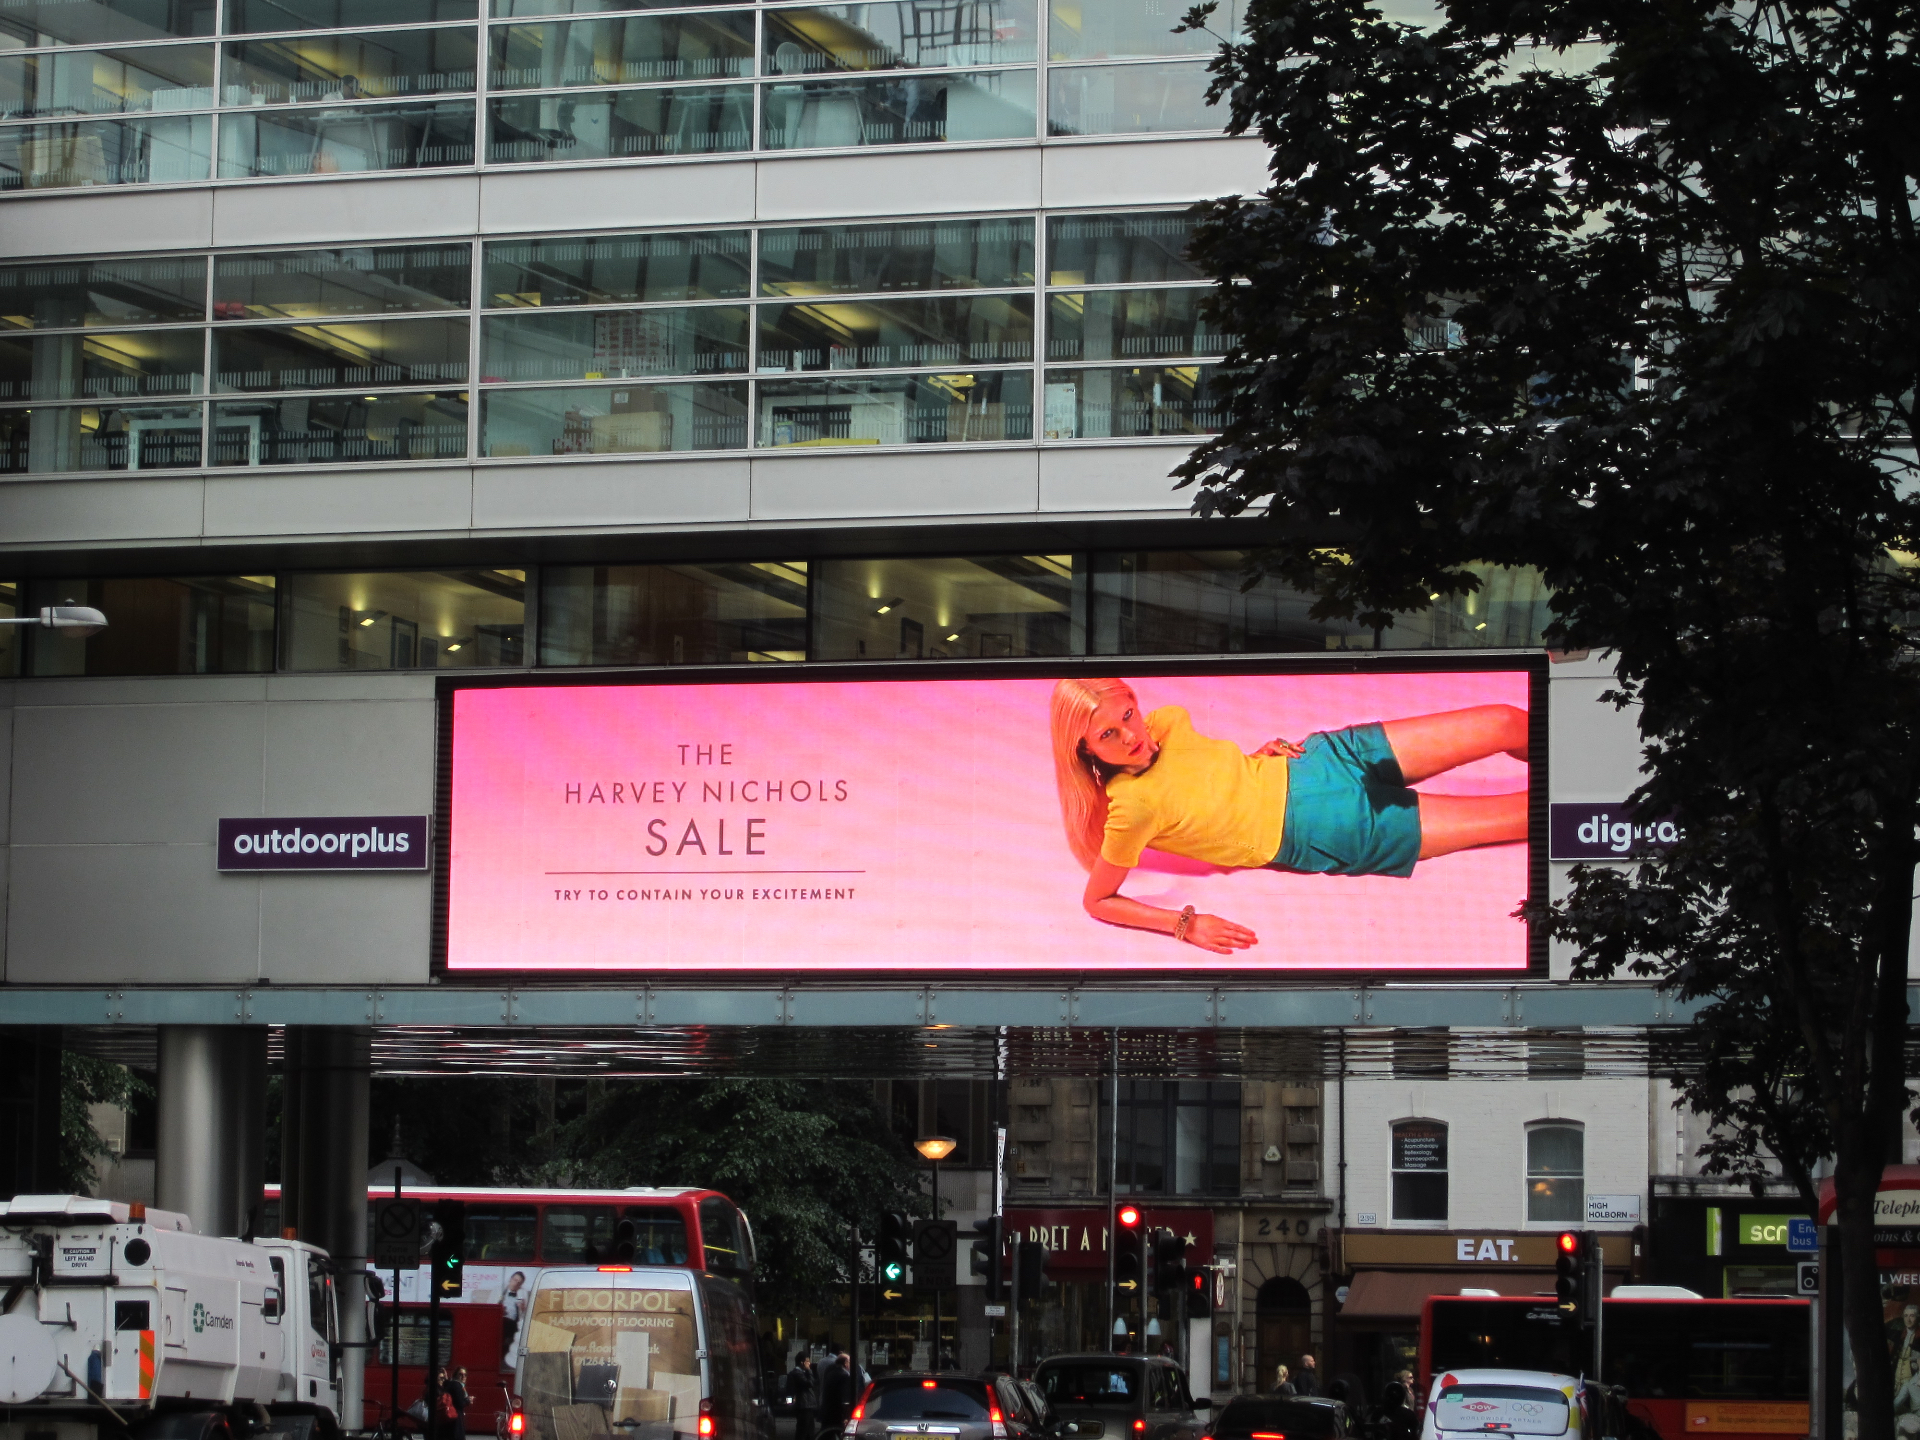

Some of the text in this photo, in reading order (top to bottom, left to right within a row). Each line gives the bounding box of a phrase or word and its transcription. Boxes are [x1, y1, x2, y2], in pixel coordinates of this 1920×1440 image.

[678, 744, 733, 766] THE
[565, 780, 849, 804] HARVEY NICHOLS
[233, 827, 410, 858] outdoorplus
[645, 817, 766, 857] SALE
[554, 888, 856, 901] TRY TO CONTAIN YOUR EXCITEMENT
[1360, 1214, 1375, 1222] 239
[1258, 1218, 1309, 1236] 240
[1030, 1225, 1070, 1251] PRET
[1080, 1226, 1090, 1251] A
[1792, 1235, 1812, 1246] bus
[1873, 1231, 1899, 1242] oins
[1901, 1230, 1913, 1243] &
[386, 1245, 408, 1253] Zone
[1456, 1238, 1519, 1262] EAT.
[380, 1255, 415, 1264] ENDS
[923, 1266, 946, 1275] Zone
[918, 1276, 952, 1286] ENDS
[1889, 1273, 1920, 1285] WEE
[549, 1290, 677, 1312] FLOORPOL
[205, 1311, 234, 1330] Camden
[548, 1316, 675, 1328] HARDWOOD FLOORING
